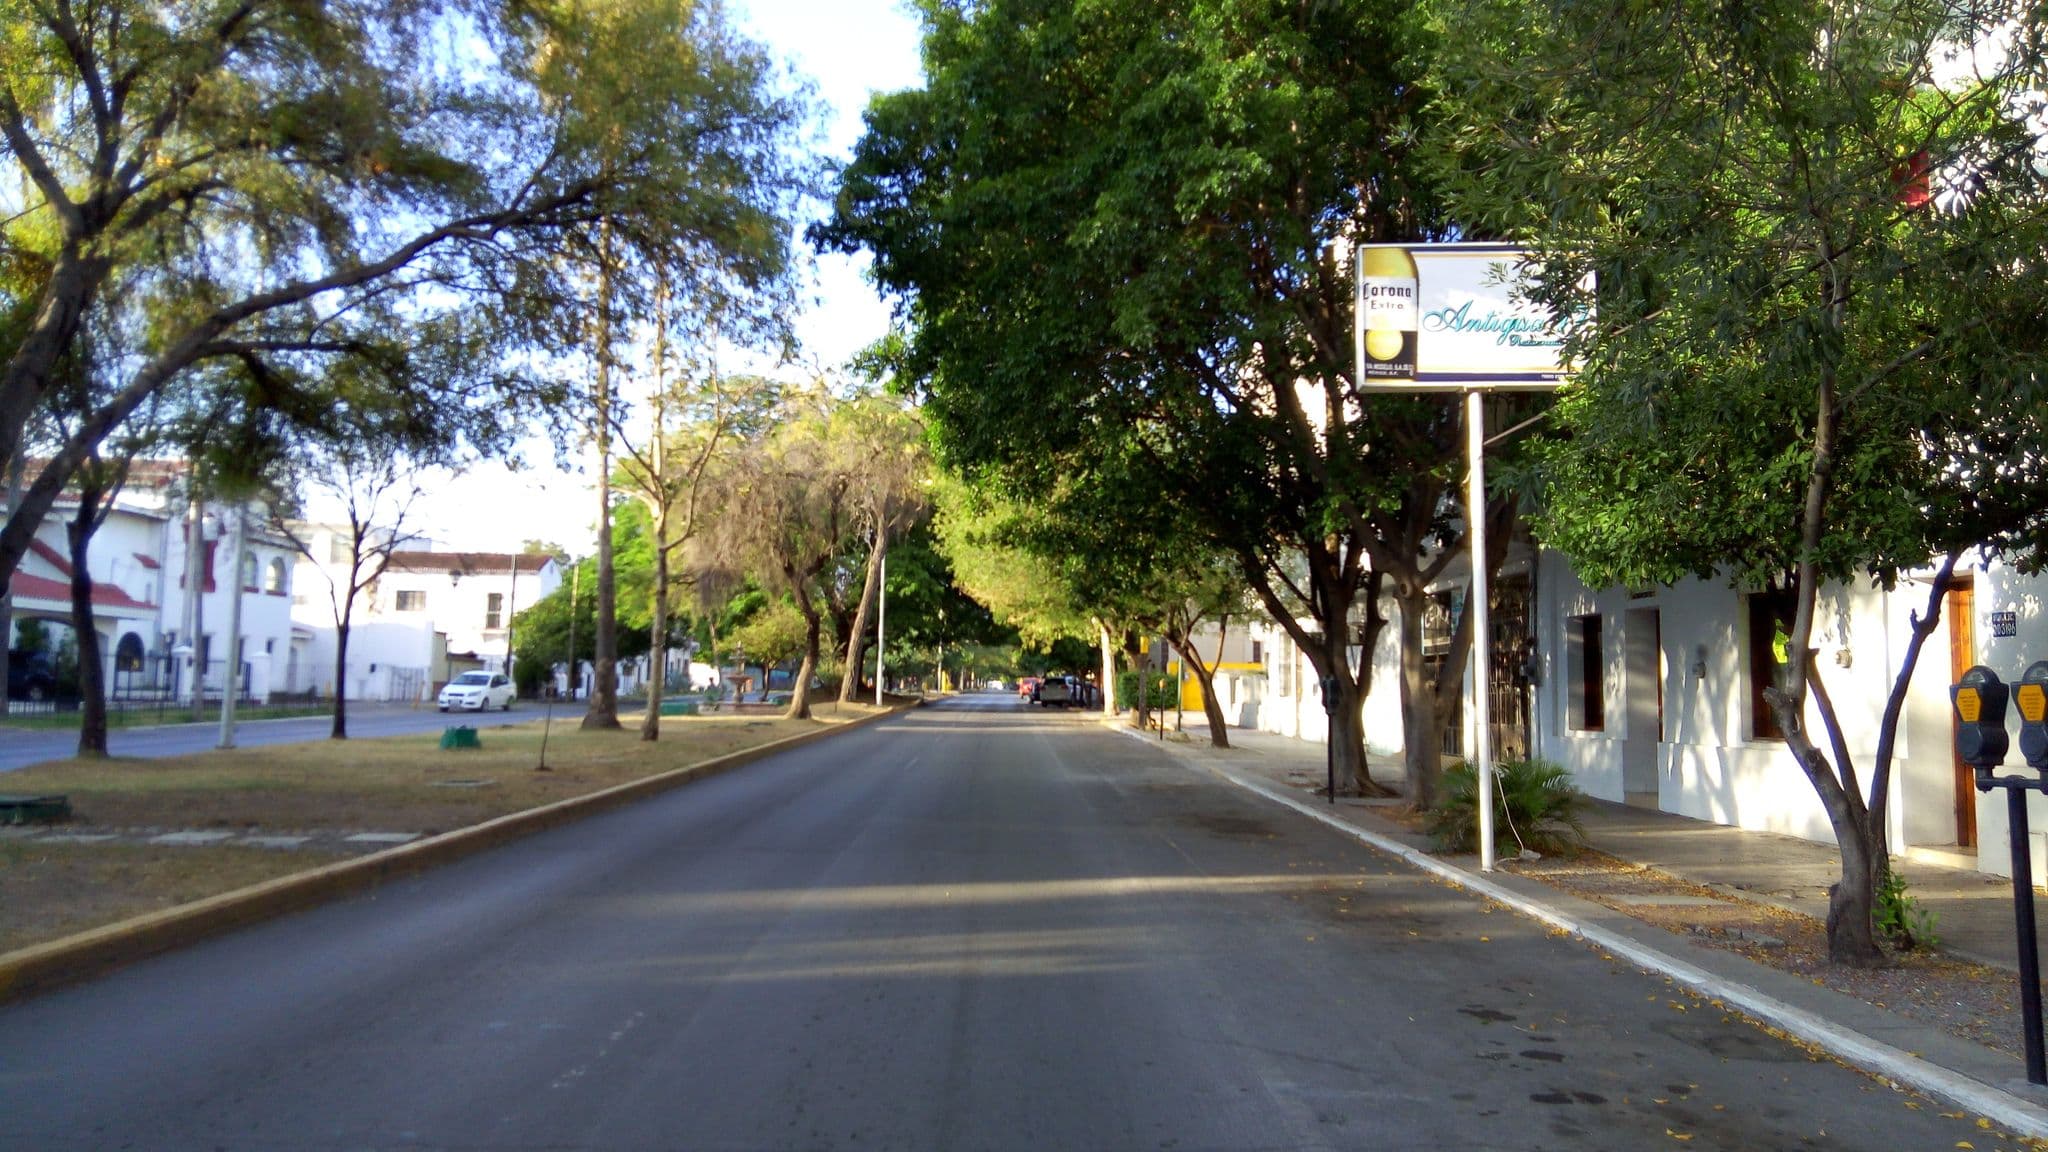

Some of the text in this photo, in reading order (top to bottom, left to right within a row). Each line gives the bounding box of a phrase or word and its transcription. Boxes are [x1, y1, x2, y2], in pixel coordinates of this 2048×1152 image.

[1363, 282, 1412, 300] Corona
[1371, 300, 1404, 310] Extra
[1422, 299, 1546, 346] Antigua
